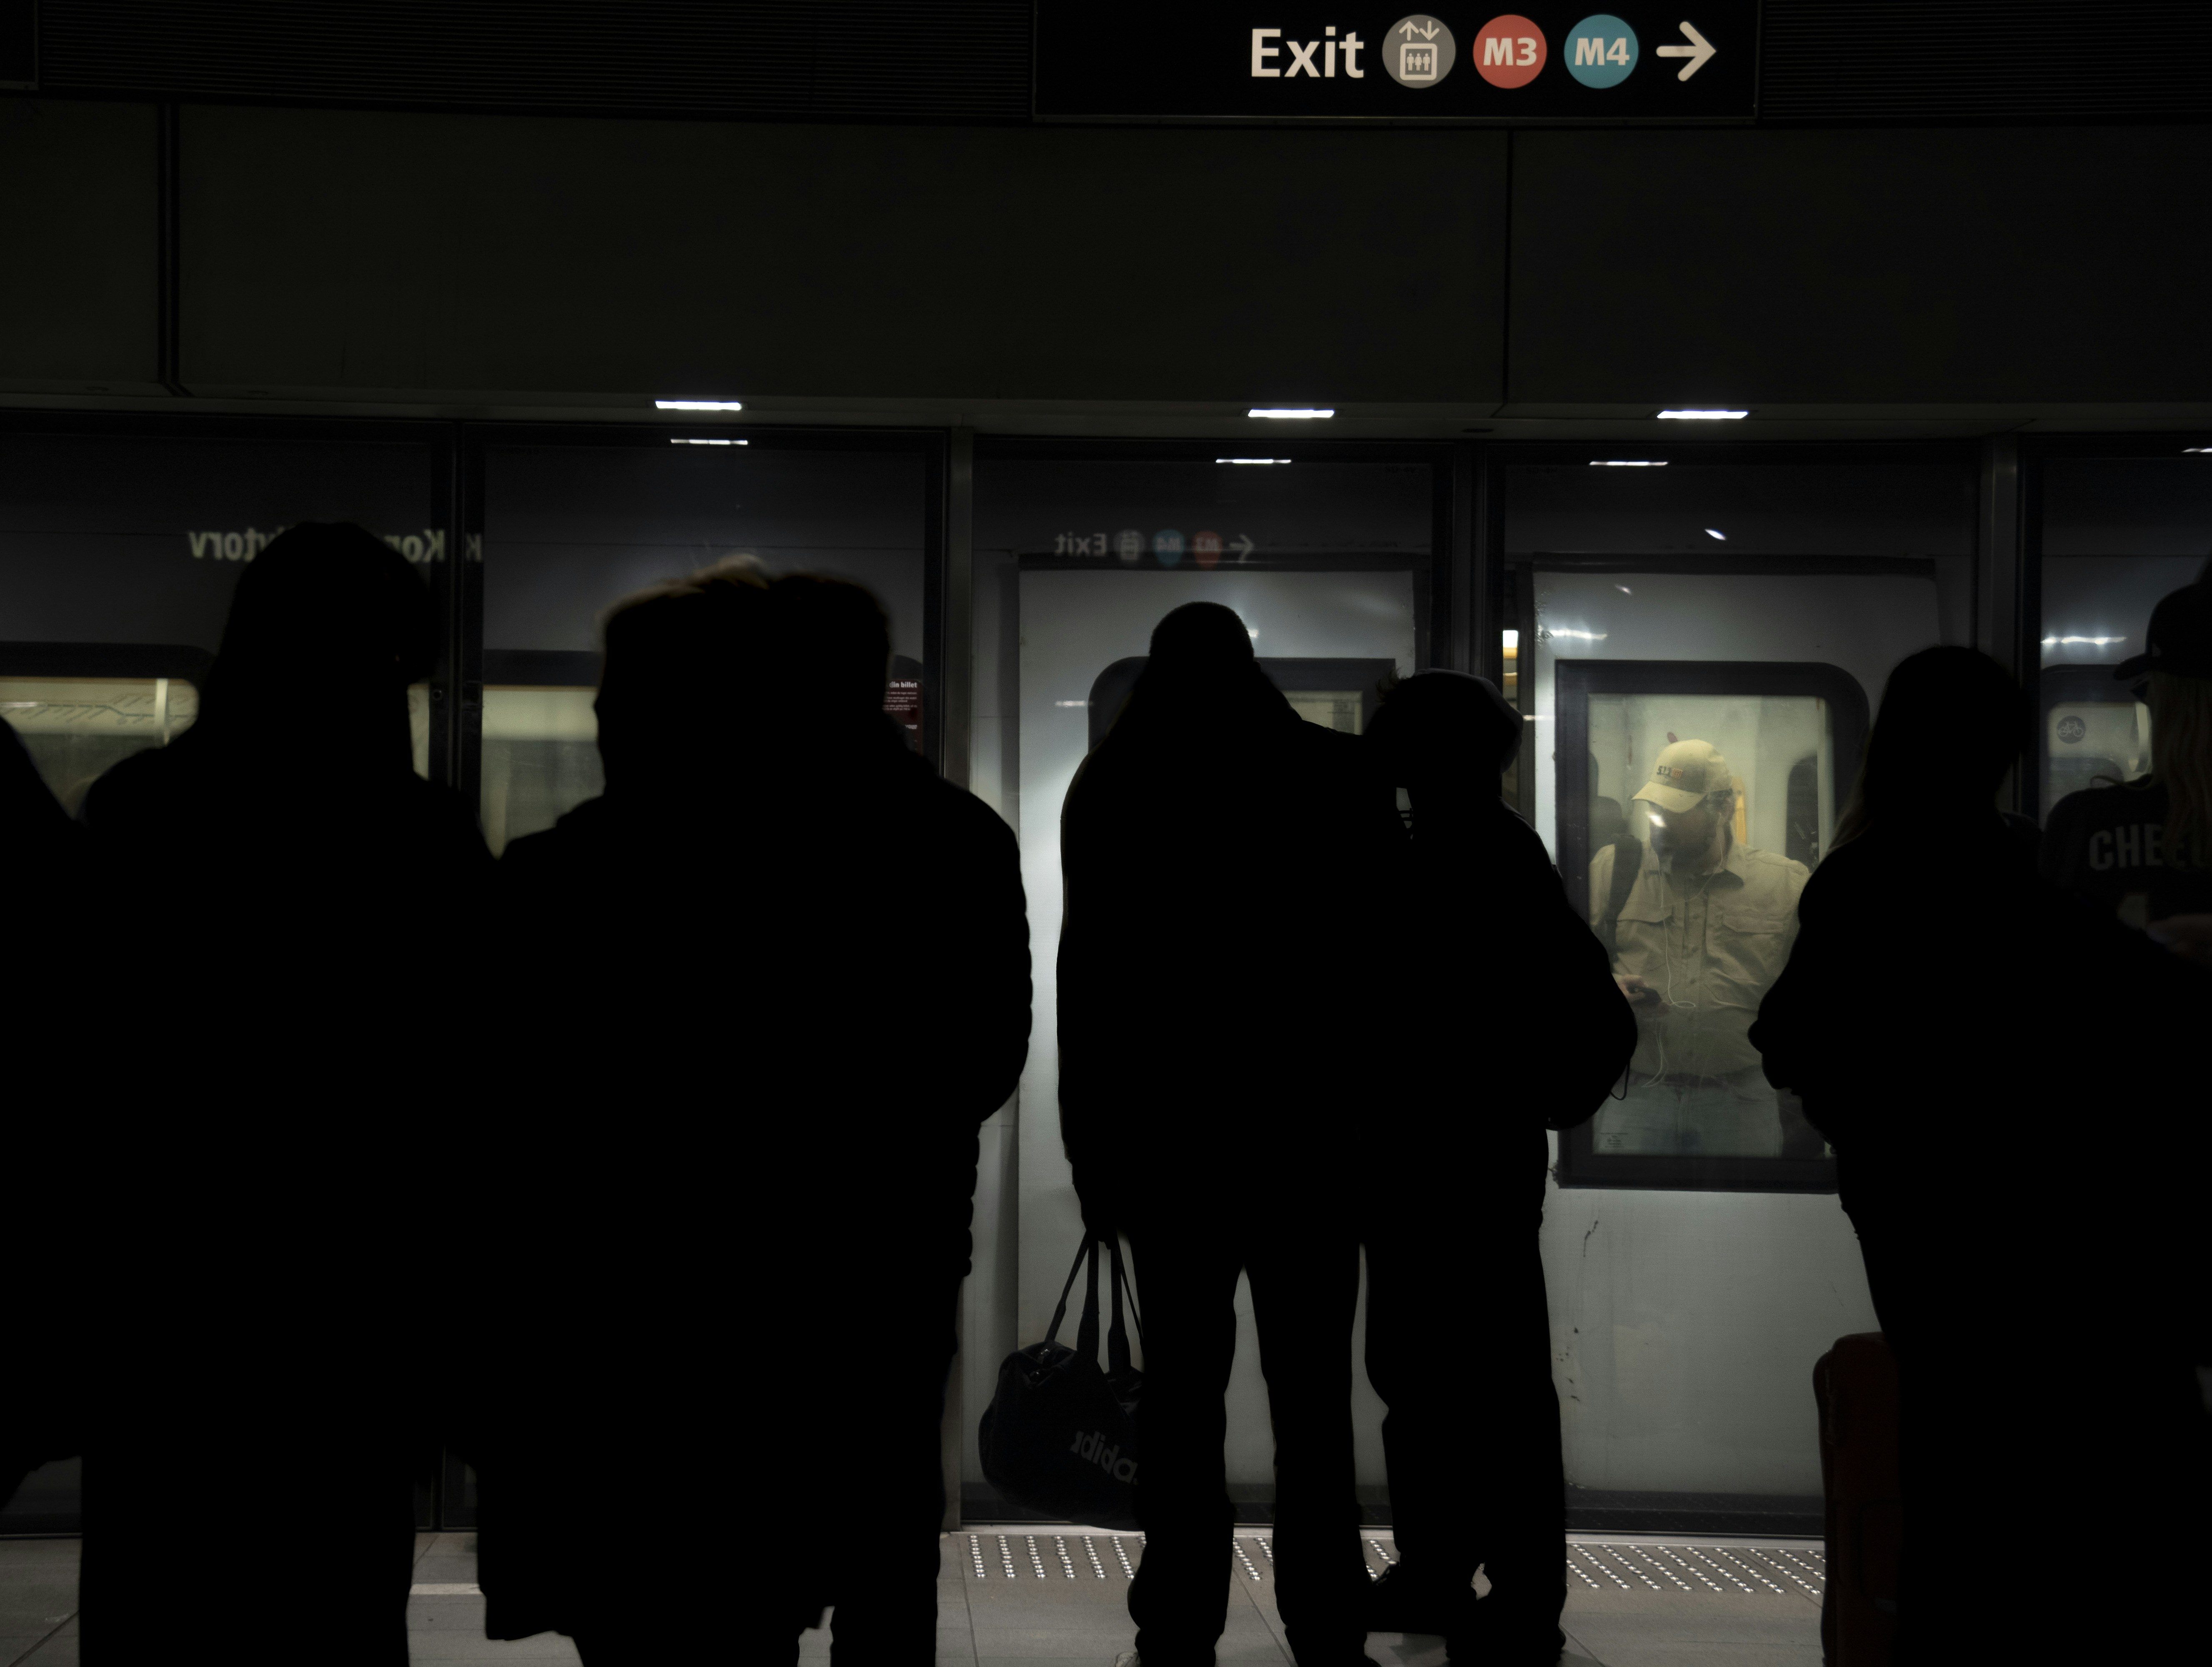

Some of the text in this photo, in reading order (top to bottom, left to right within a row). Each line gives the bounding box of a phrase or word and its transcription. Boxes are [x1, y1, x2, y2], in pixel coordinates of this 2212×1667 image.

[1251, 25, 1631, 79] Exit M3 M4
